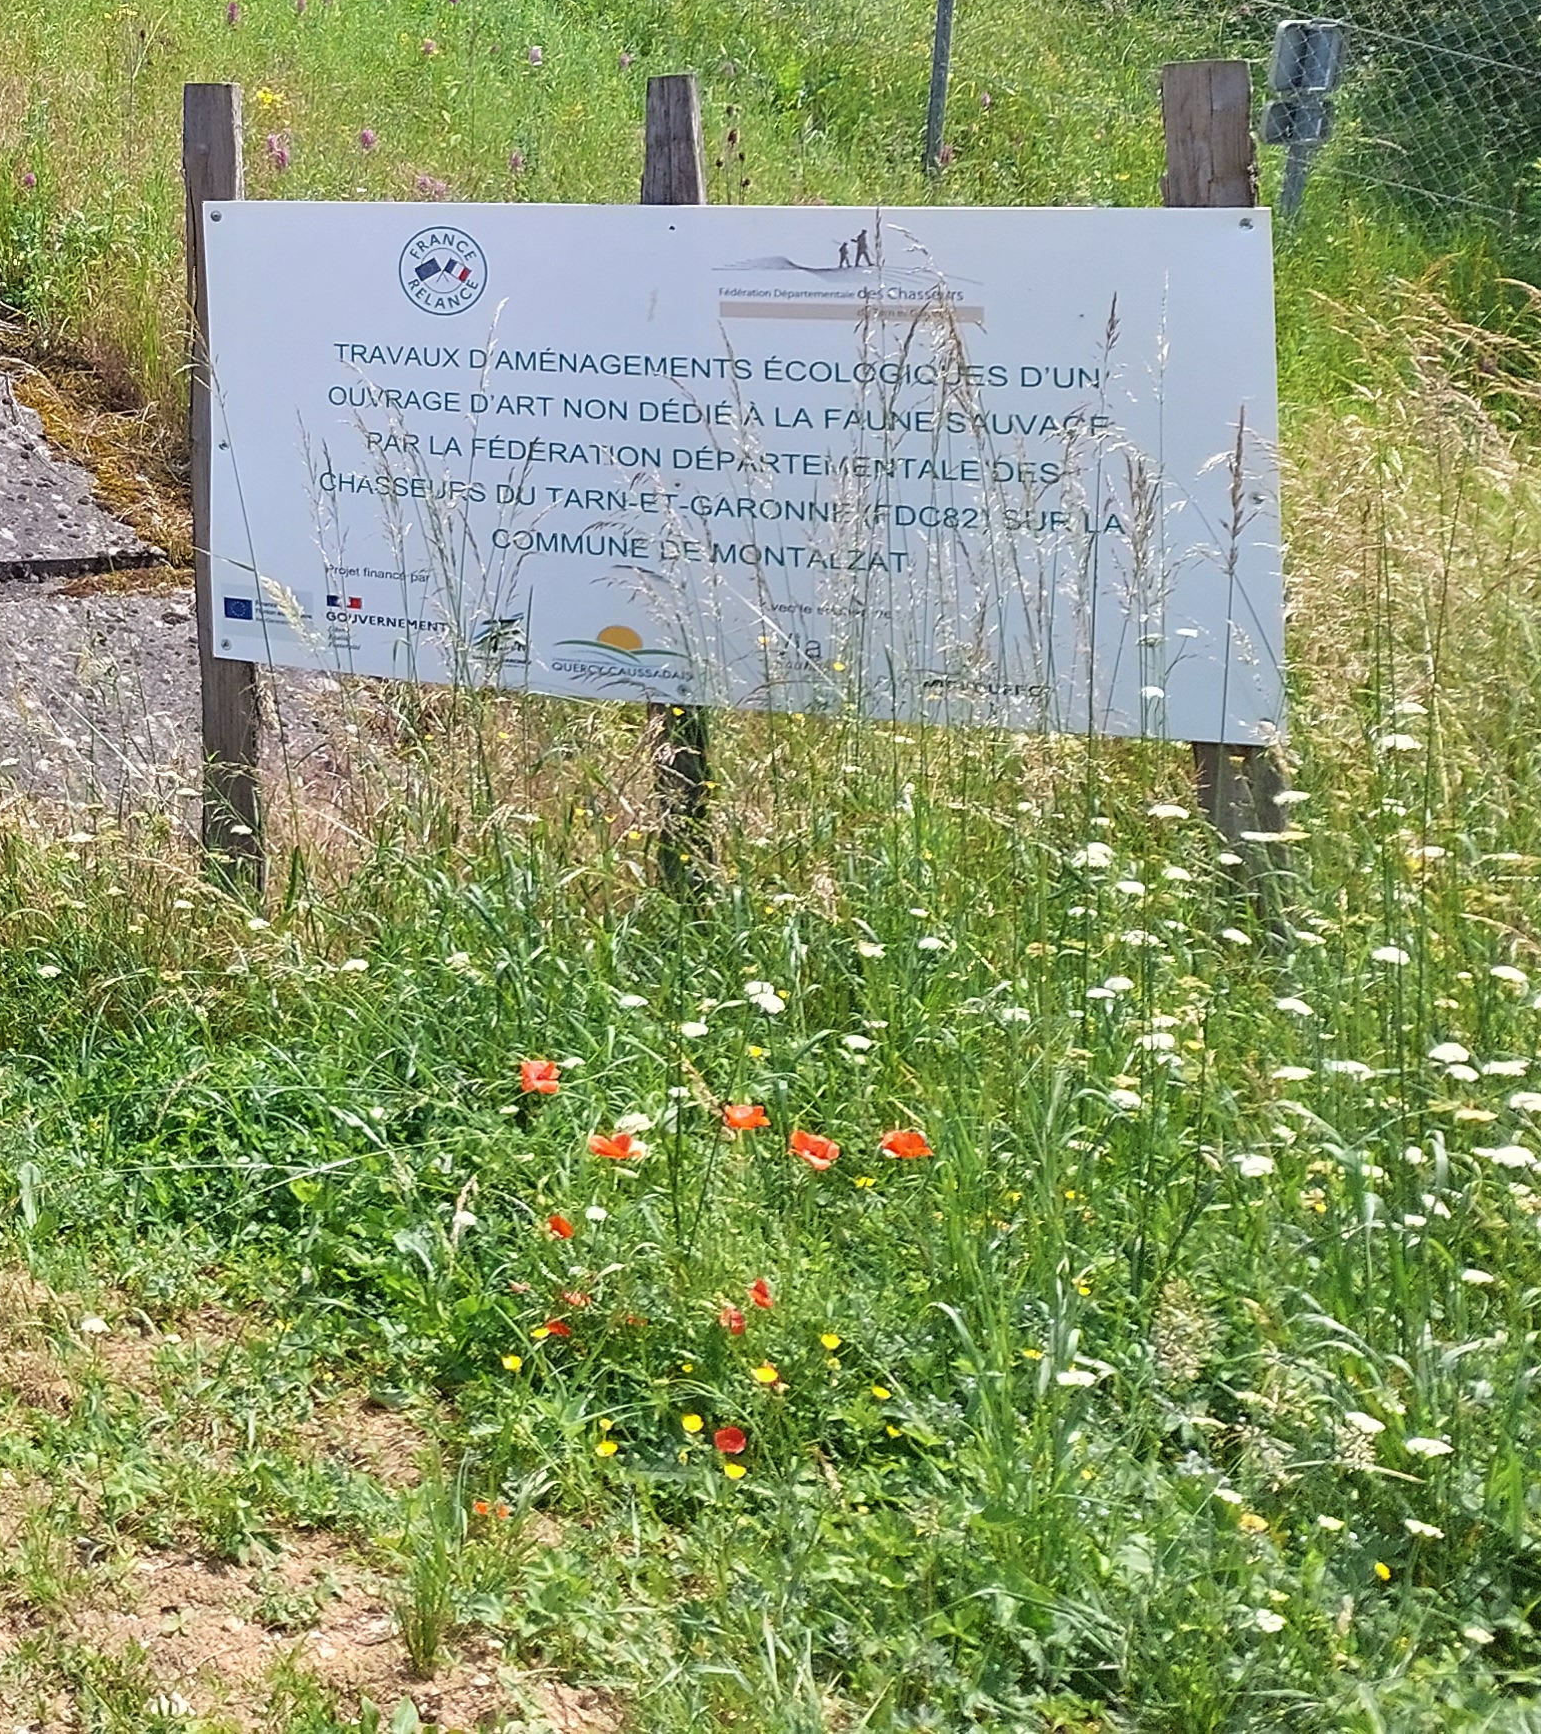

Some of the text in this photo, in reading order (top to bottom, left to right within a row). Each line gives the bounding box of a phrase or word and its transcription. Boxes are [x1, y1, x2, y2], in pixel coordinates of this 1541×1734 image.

[409, 232, 478, 262] FRANCE
[407, 278, 480, 310] RELANCE
[718, 286, 770, 299] Fédération
[774, 287, 856, 300] Départementale
[857, 285, 884, 300] des
[333, 342, 1101, 390] TRAVAUX D'AMÉNAGEMENTS ÉCOLOGIQUES D'UN
[328, 385, 461, 413] OUVRAGE
[470, 393, 554, 418] D'ART
[563, 397, 628, 422] NON
[638, 397, 733, 426] DÉDIÉ
[742, 401, 765, 427] À
[774, 406, 814, 429] LA
[823, 407, 935, 434] FAUNE
[367, 431, 1061, 485] PAR LA FÉDÉRATION DÉPARTEMENTALE DES
[319, 471, 487, 503] CHASSEURS
[496, 483, 536, 506] DU
[545, 486, 852, 524] TARN-ET-GARONNE
[1003, 508, 1073, 533] SUR
[1084, 512, 1126, 535] LA
[491, 528, 908, 574] COMMUNE DE MONTALZAT
[325, 563, 431, 584] Projet financé par
[325, 611, 448, 632] GOUVERNEMENT
[552, 661, 694, 682] QUERCY CAUSSADAIS
